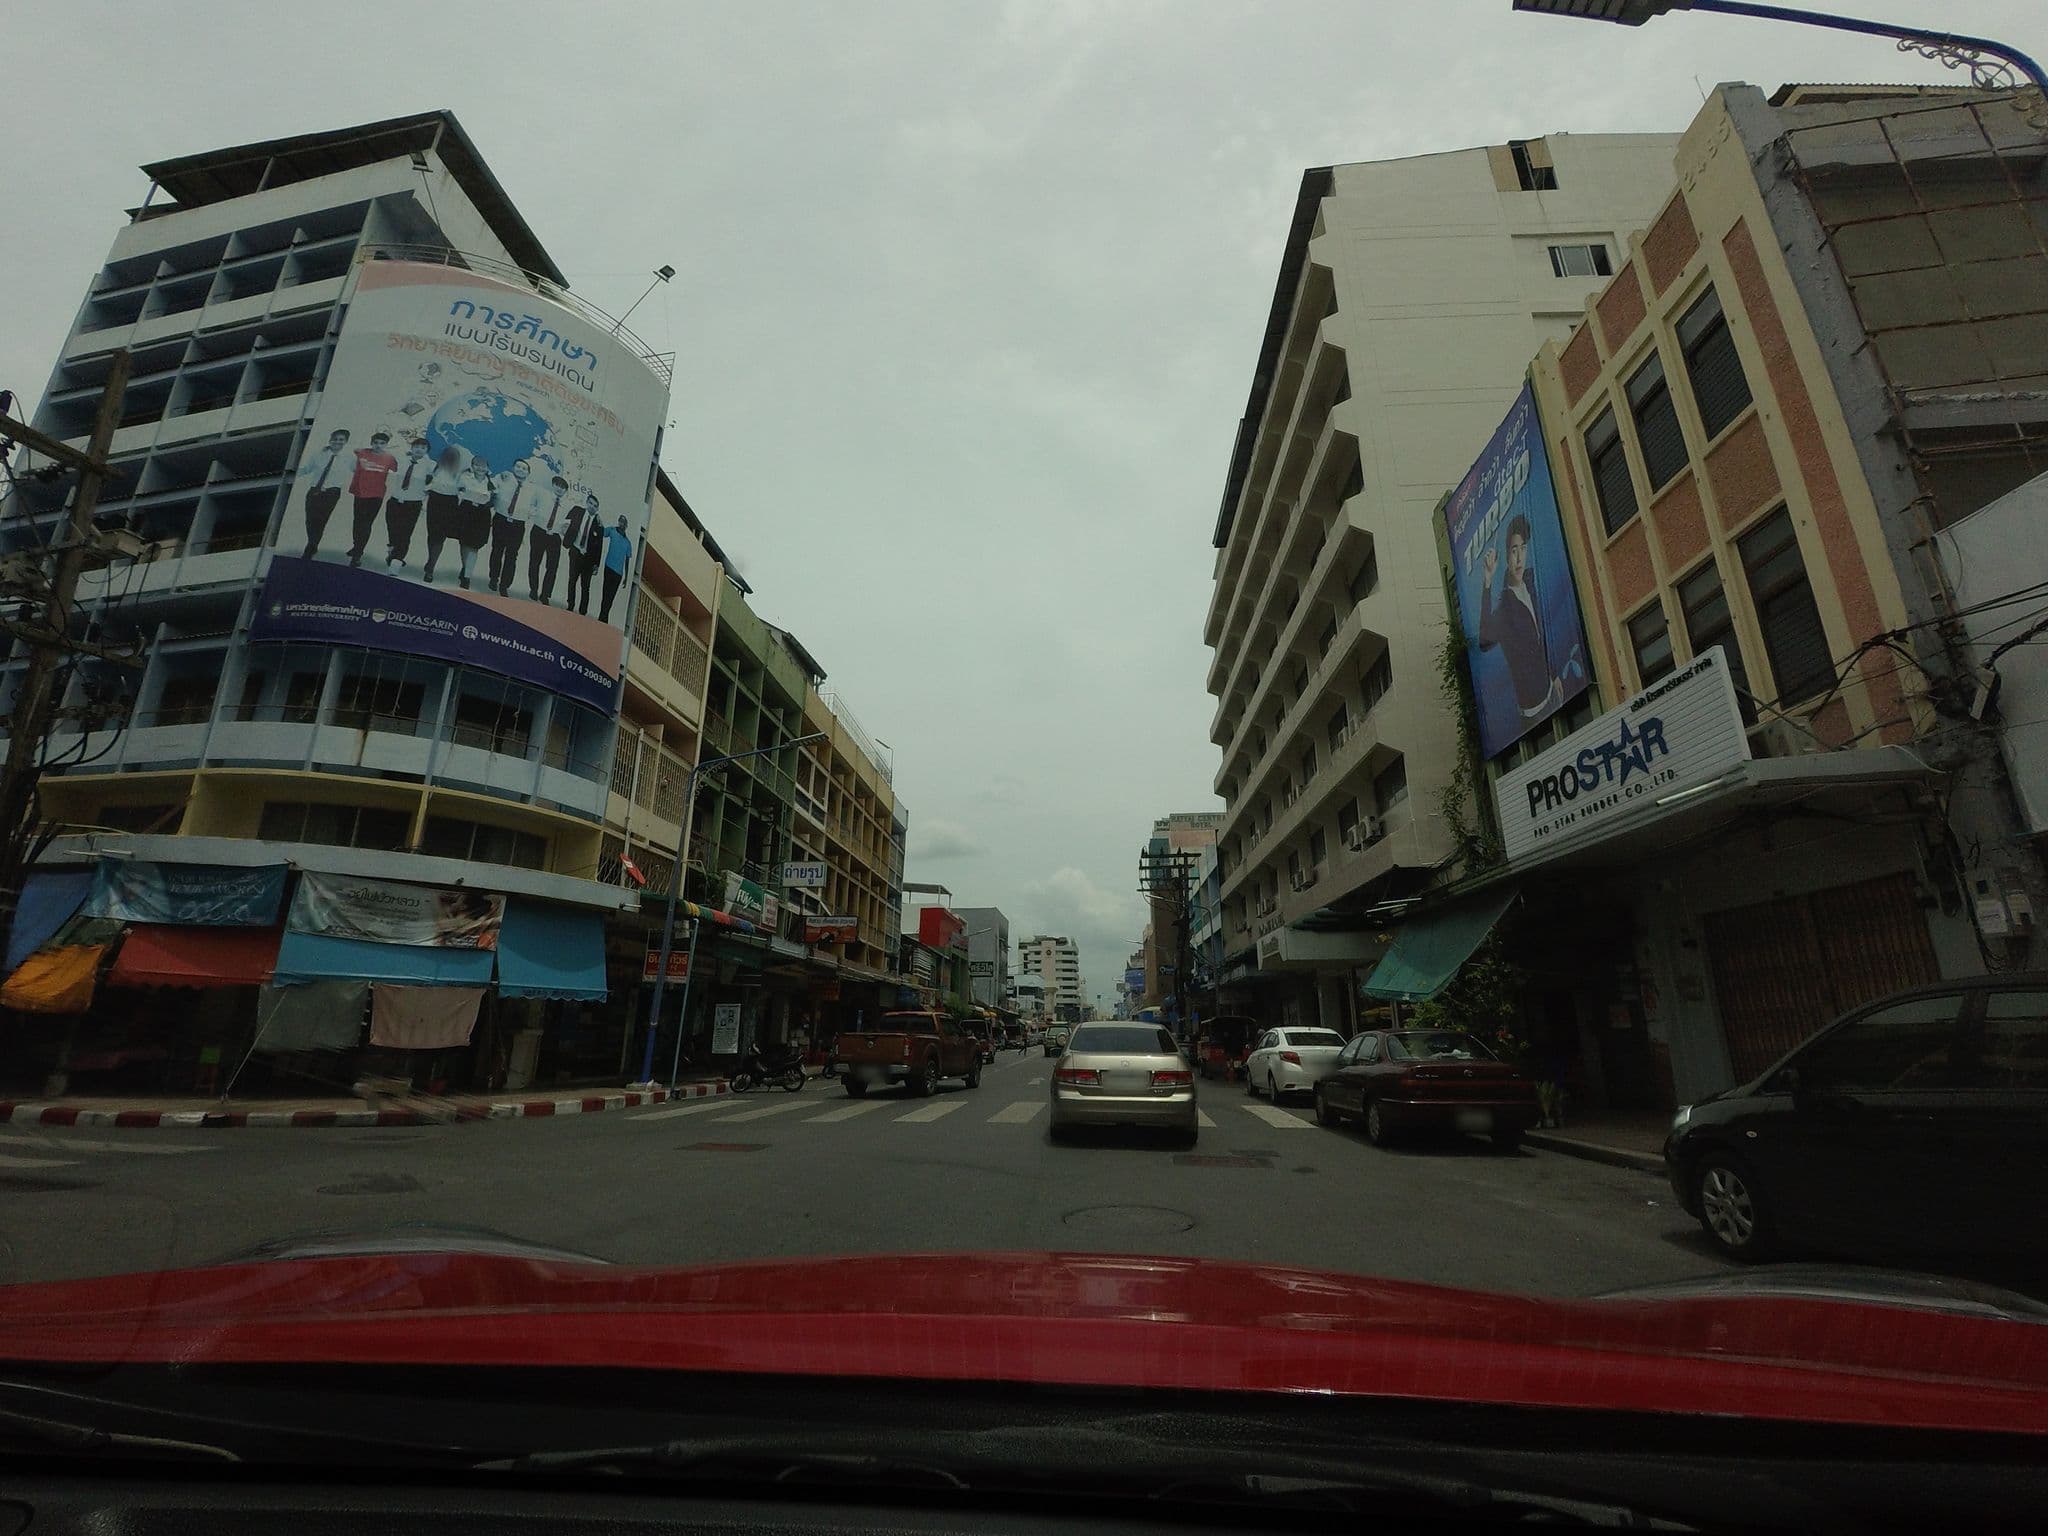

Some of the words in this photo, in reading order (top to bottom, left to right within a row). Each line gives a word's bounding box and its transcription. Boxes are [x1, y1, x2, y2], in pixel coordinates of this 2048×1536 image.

[450, 300, 598, 372] การศึกษา
[445, 322, 594, 393] แบบไร้พรมแดน
[569, 480, 592, 495] idea
[1464, 449, 1530, 577] TURBO
[387, 610, 459, 632] DIDYASARIN
[480, 631, 555, 662] www.hu.ac.th
[566, 660, 583, 674] 074
[583, 670, 612, 689] 200300
[1533, 825, 1550, 839] PRO
[1554, 812, 1576, 830] STAR
[1581, 793, 1619, 818] RUBBER
[784, 863, 824, 885] ถ่ายรูป
